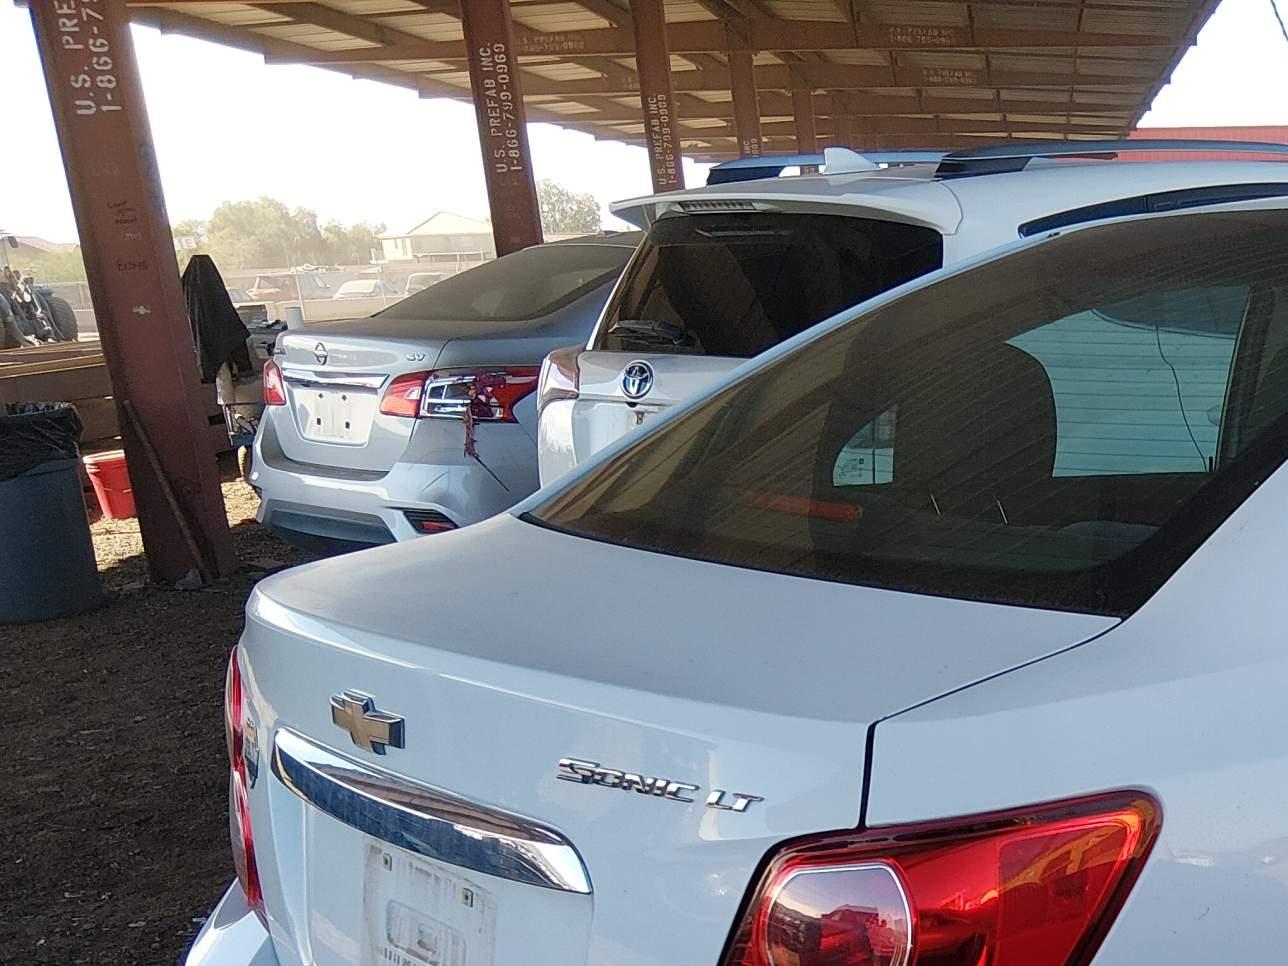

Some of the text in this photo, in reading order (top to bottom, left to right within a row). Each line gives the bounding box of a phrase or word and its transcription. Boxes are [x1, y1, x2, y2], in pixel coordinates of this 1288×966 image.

[81, 0, 122, 112] 1-866-7
[71, 66, 97, 115] U.S.
[484, 79, 503, 136] PREFAB
[493, 43, 522, 171] 1-866-799-0969
[494, 145, 508, 173] U.S.
[650, 119, 664, 160] PREFAB
[406, 353, 426, 362] SV
[557, 757, 765, 813] SONIC LT
